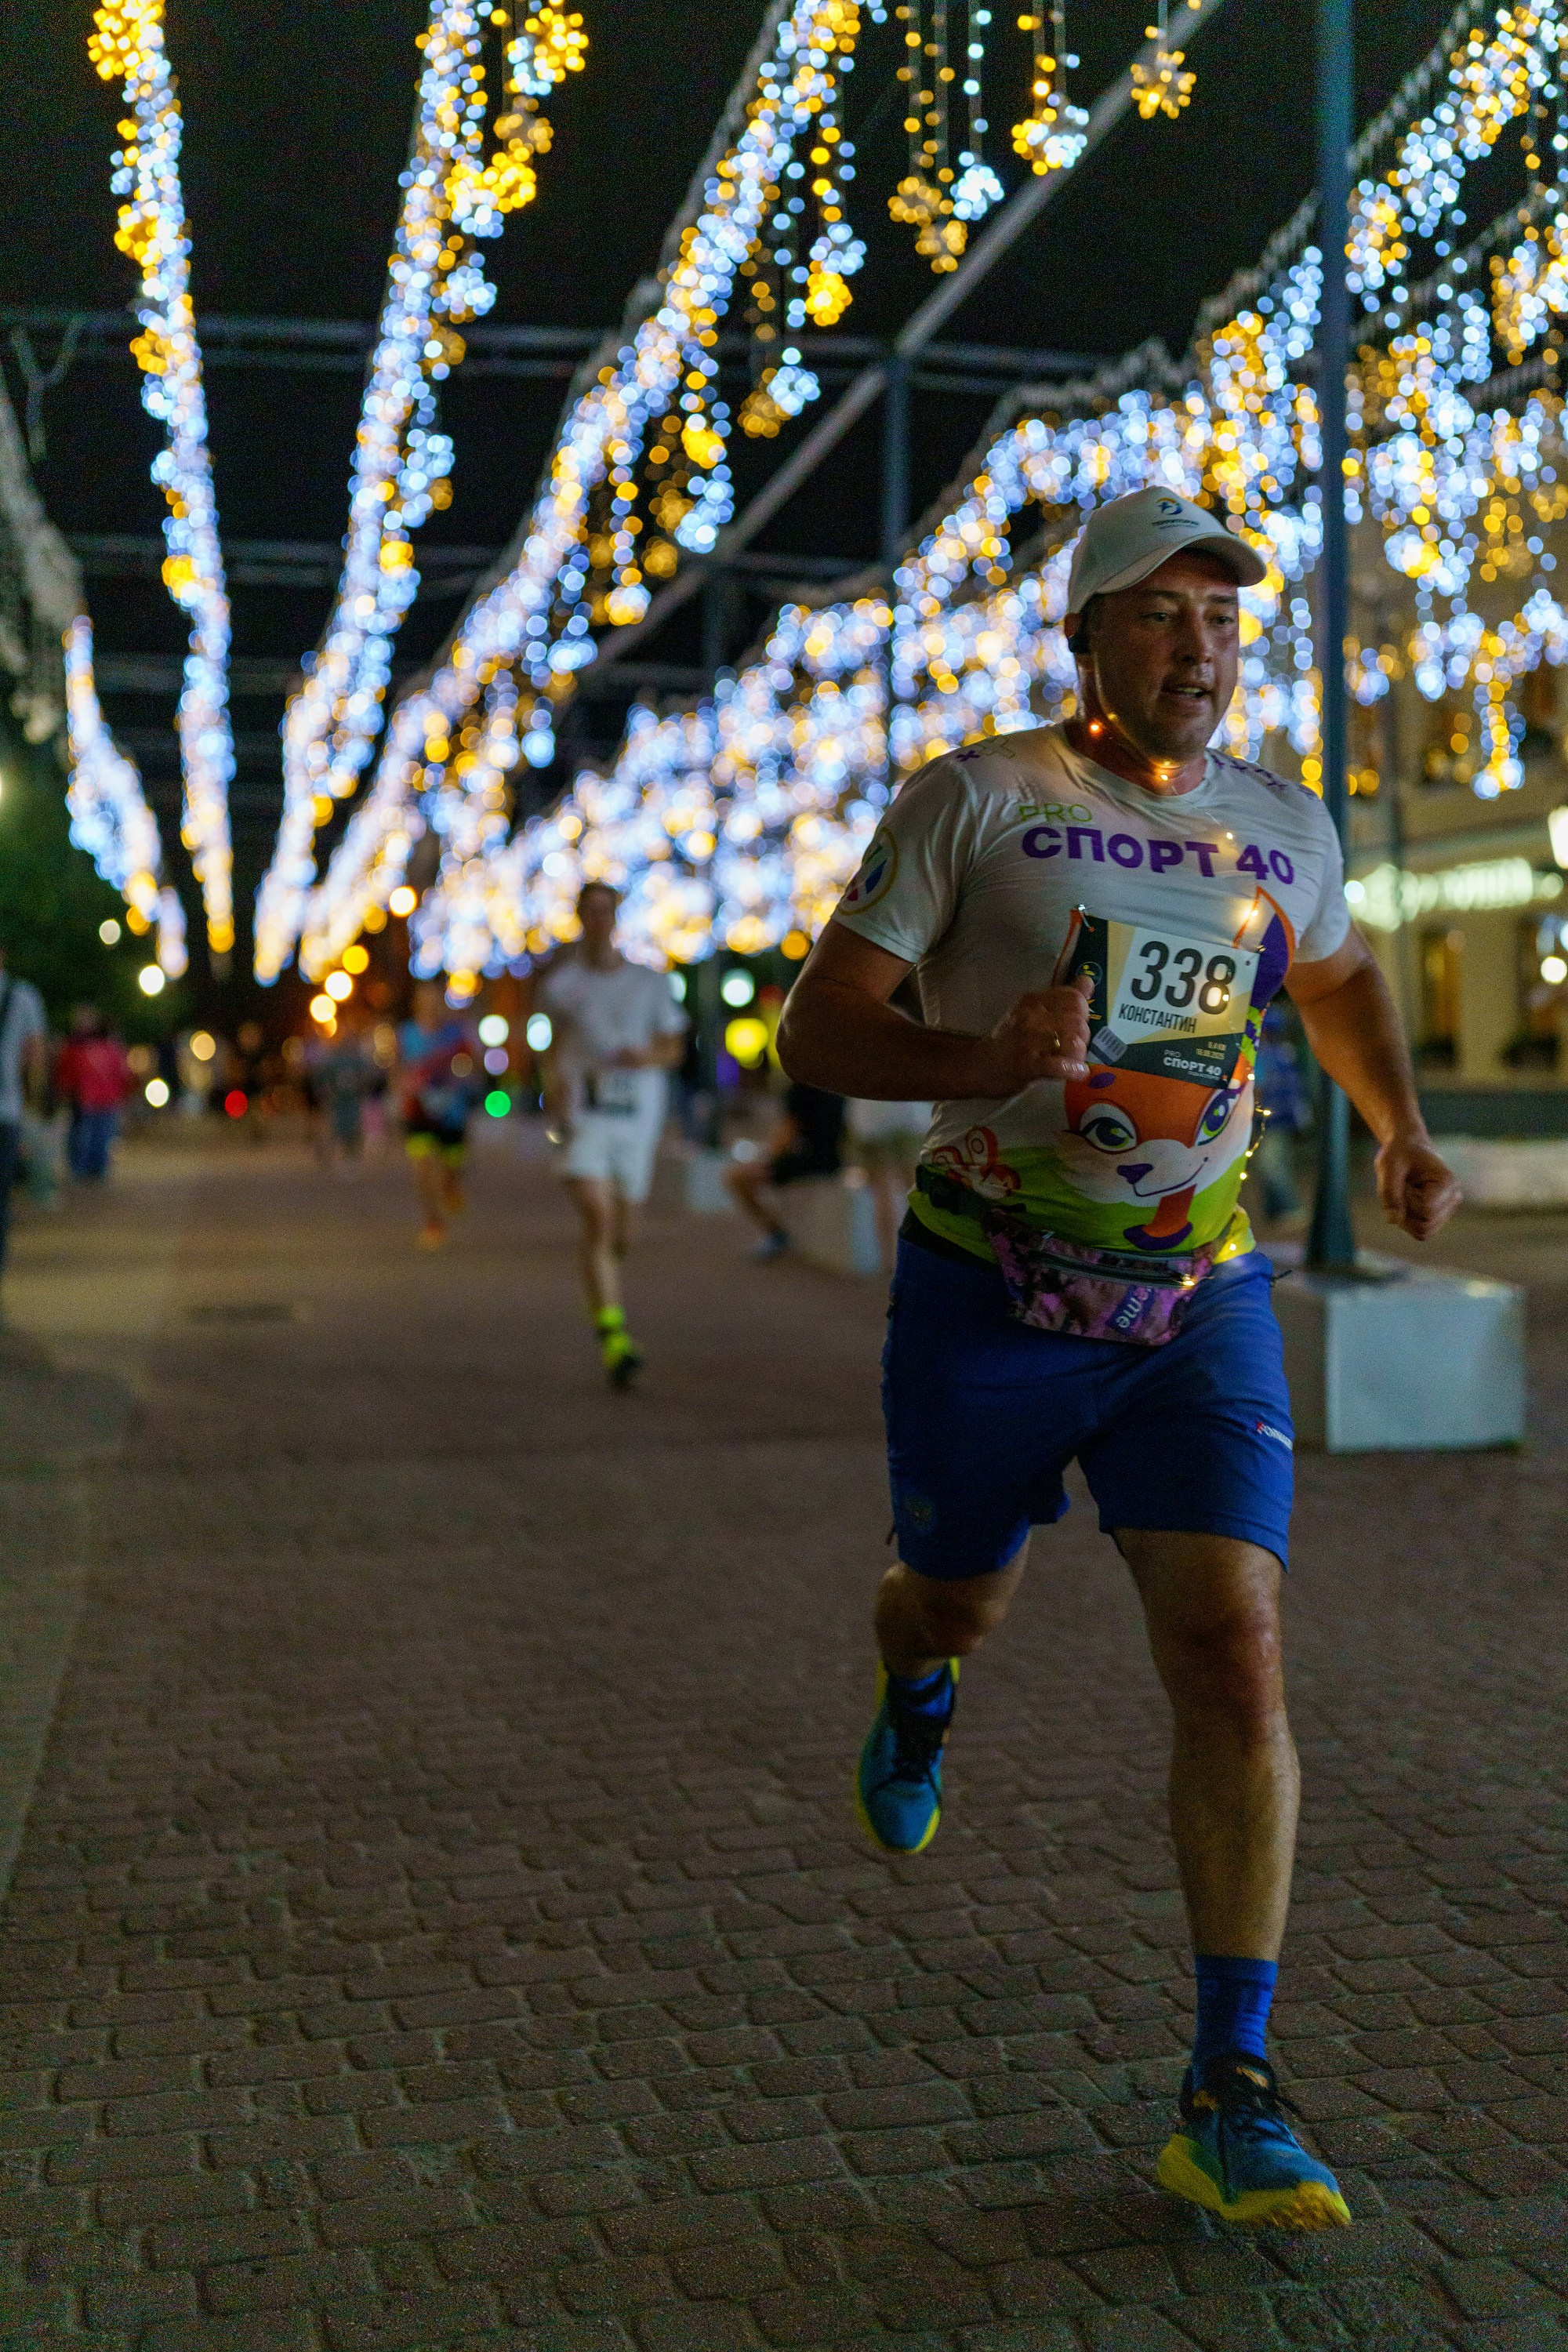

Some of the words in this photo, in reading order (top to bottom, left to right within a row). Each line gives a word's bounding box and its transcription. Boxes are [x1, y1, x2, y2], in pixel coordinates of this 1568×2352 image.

[1020, 803, 1093, 823] PRO
[1022, 826, 1220, 878] СПОРТ
[1236, 844, 1295, 885] 40
[1131, 940, 1236, 1015] 338
[1119, 1003, 1198, 1034] КОНСТАНТИН
[1163, 1056, 1206, 1073] СПОРТ
[1206, 1065, 1222, 1076] 40
